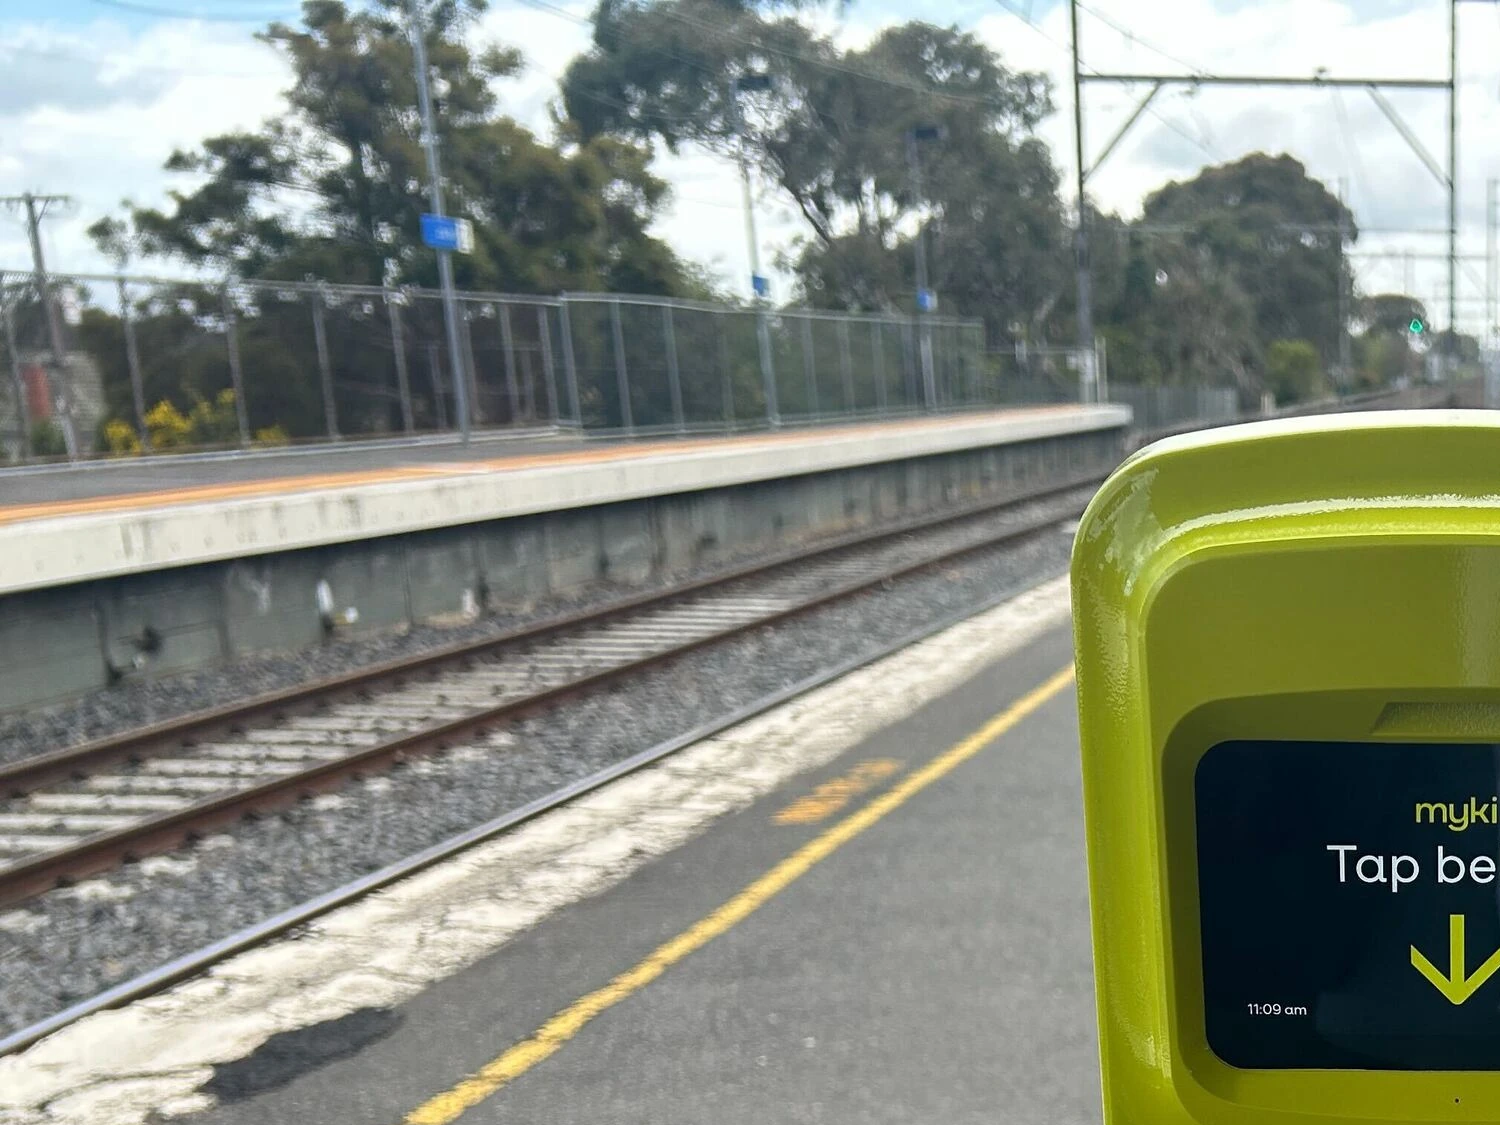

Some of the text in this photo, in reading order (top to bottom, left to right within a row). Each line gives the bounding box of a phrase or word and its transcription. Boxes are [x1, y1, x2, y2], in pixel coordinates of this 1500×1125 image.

[1415, 796, 1498, 832] myki
[1326, 844, 1420, 893] Tap
[1247, 1003, 1307, 1016] 11:09 am
